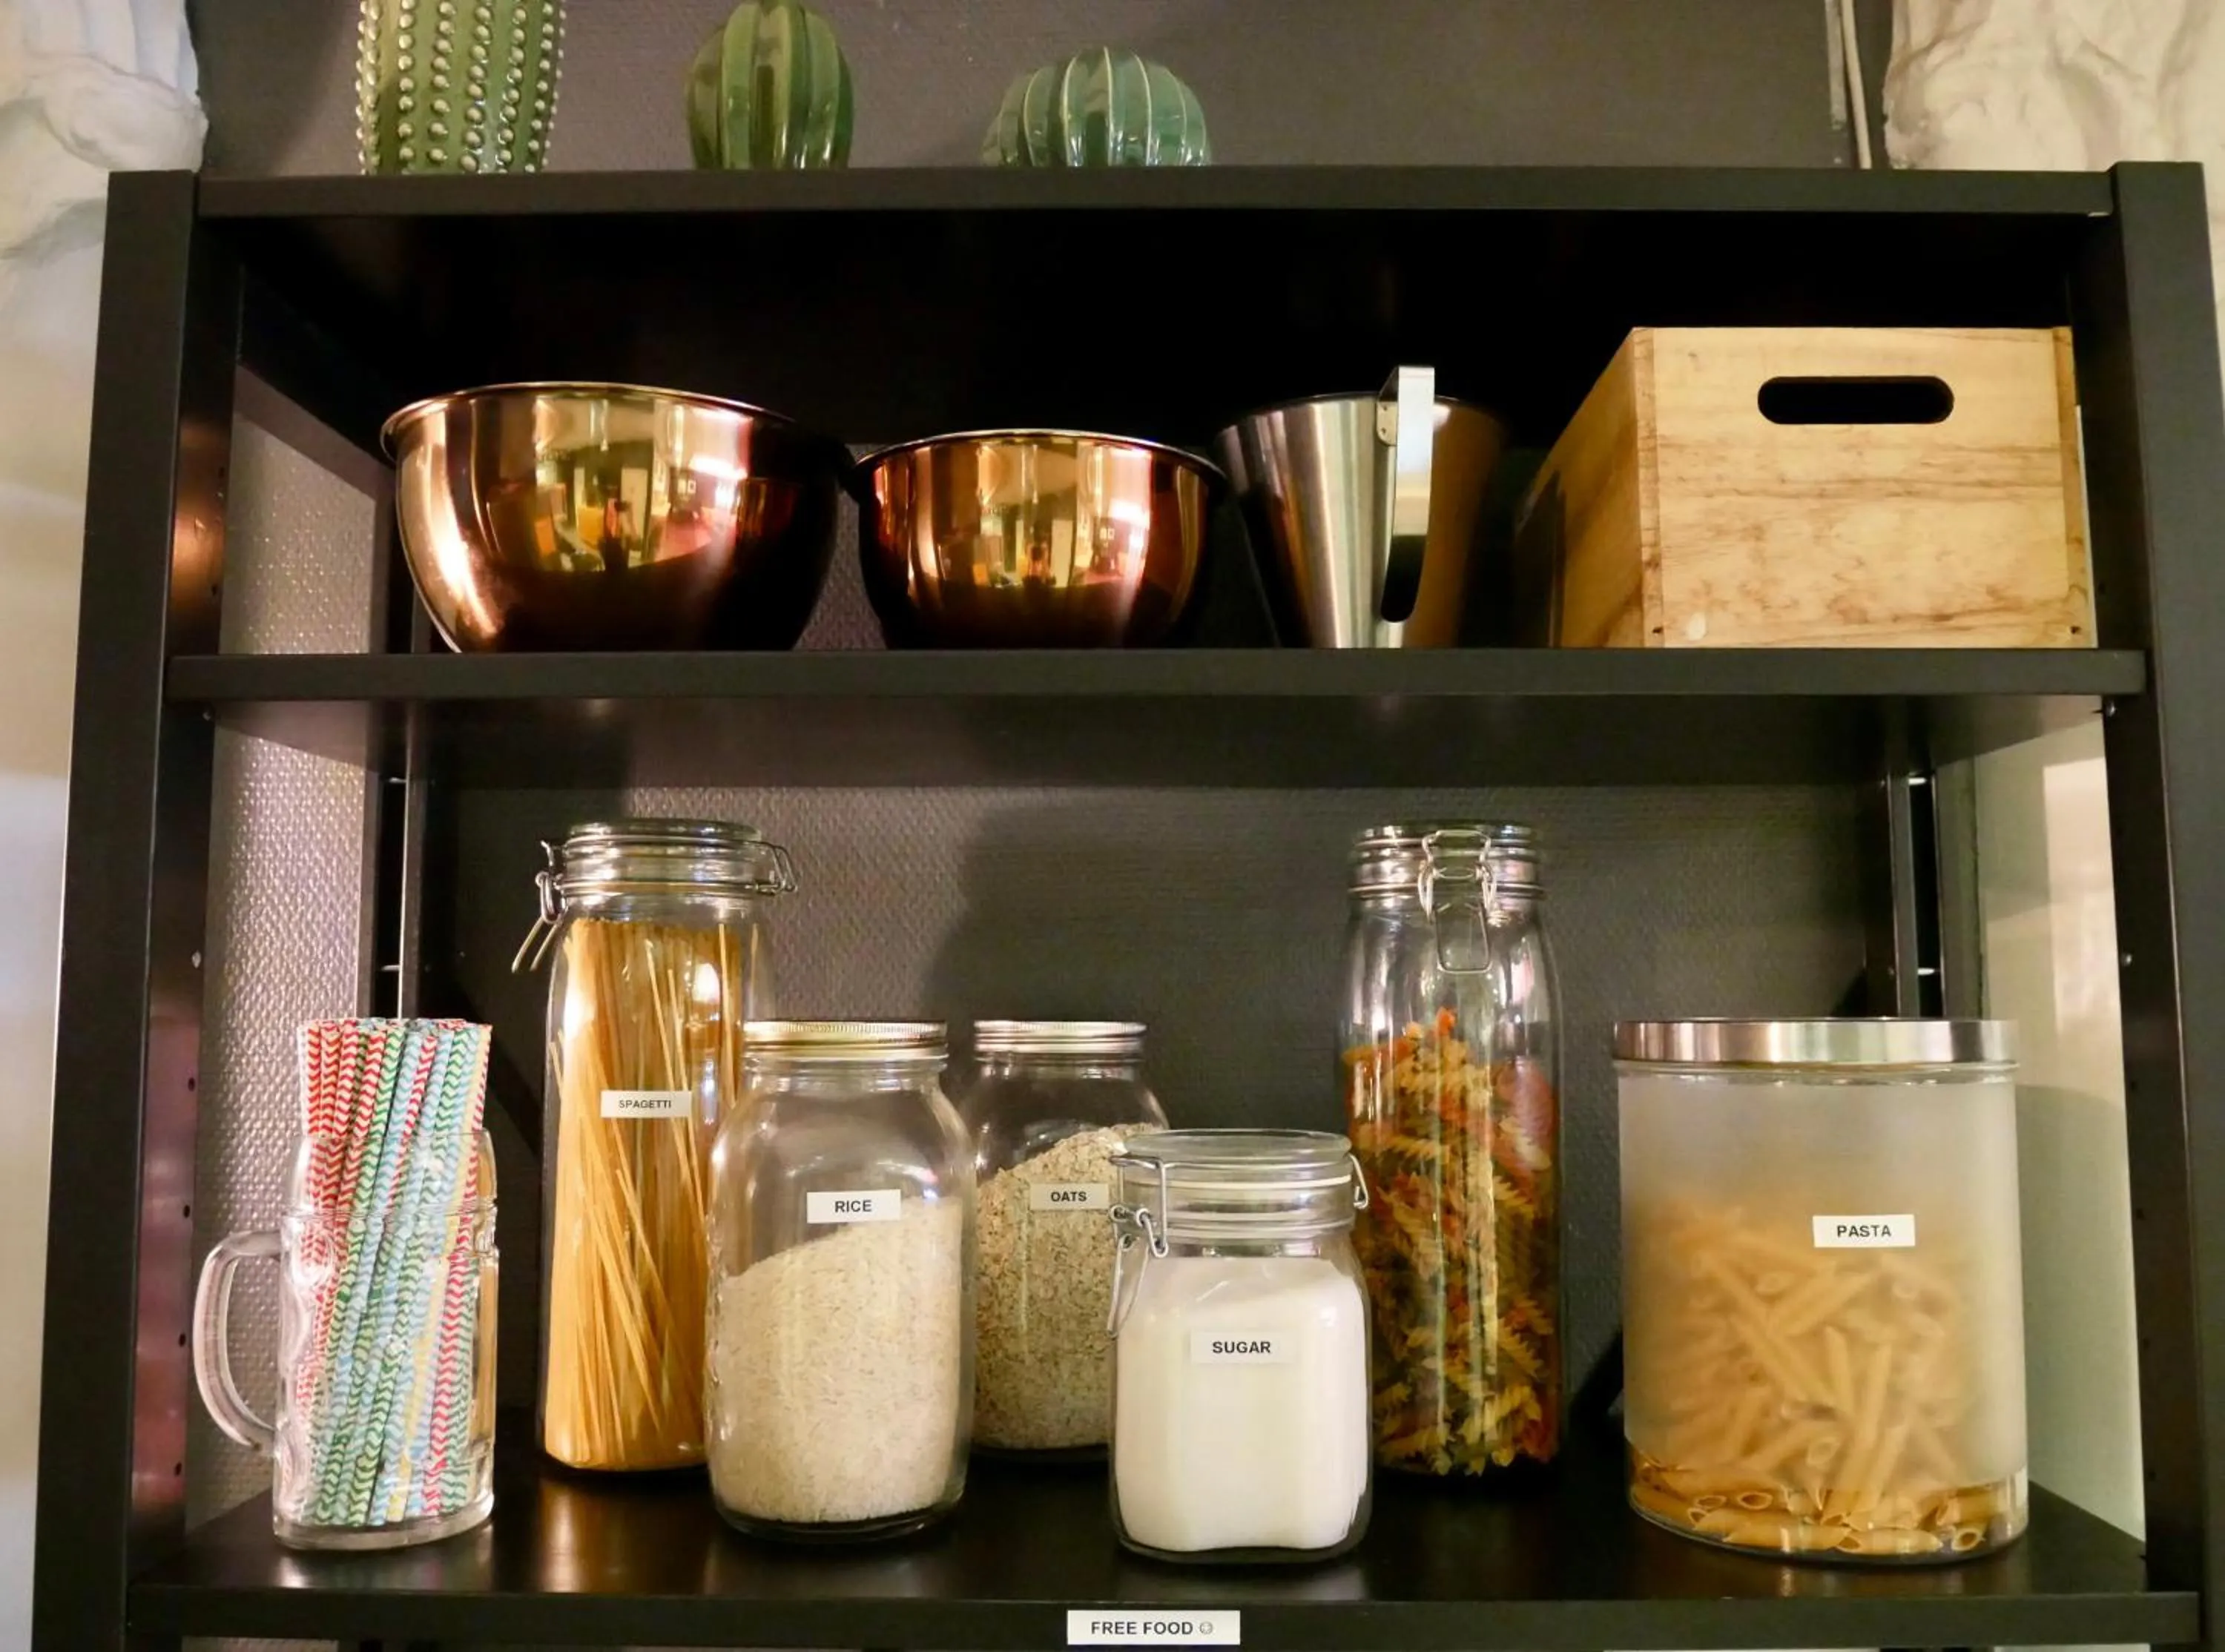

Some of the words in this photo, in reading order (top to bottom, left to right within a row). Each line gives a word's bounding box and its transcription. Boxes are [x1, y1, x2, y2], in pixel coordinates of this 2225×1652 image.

[619, 1099, 672, 1109] SPAGETTI
[1050, 1191, 1087, 1203] OATS
[834, 1200, 872, 1212] RICE
[1836, 1225, 1892, 1238] PASTA
[1212, 1341, 1271, 1353] SUGAR
[1091, 1622, 1138, 1634] FREE
[1142, 1622, 1193, 1635] FOOD
